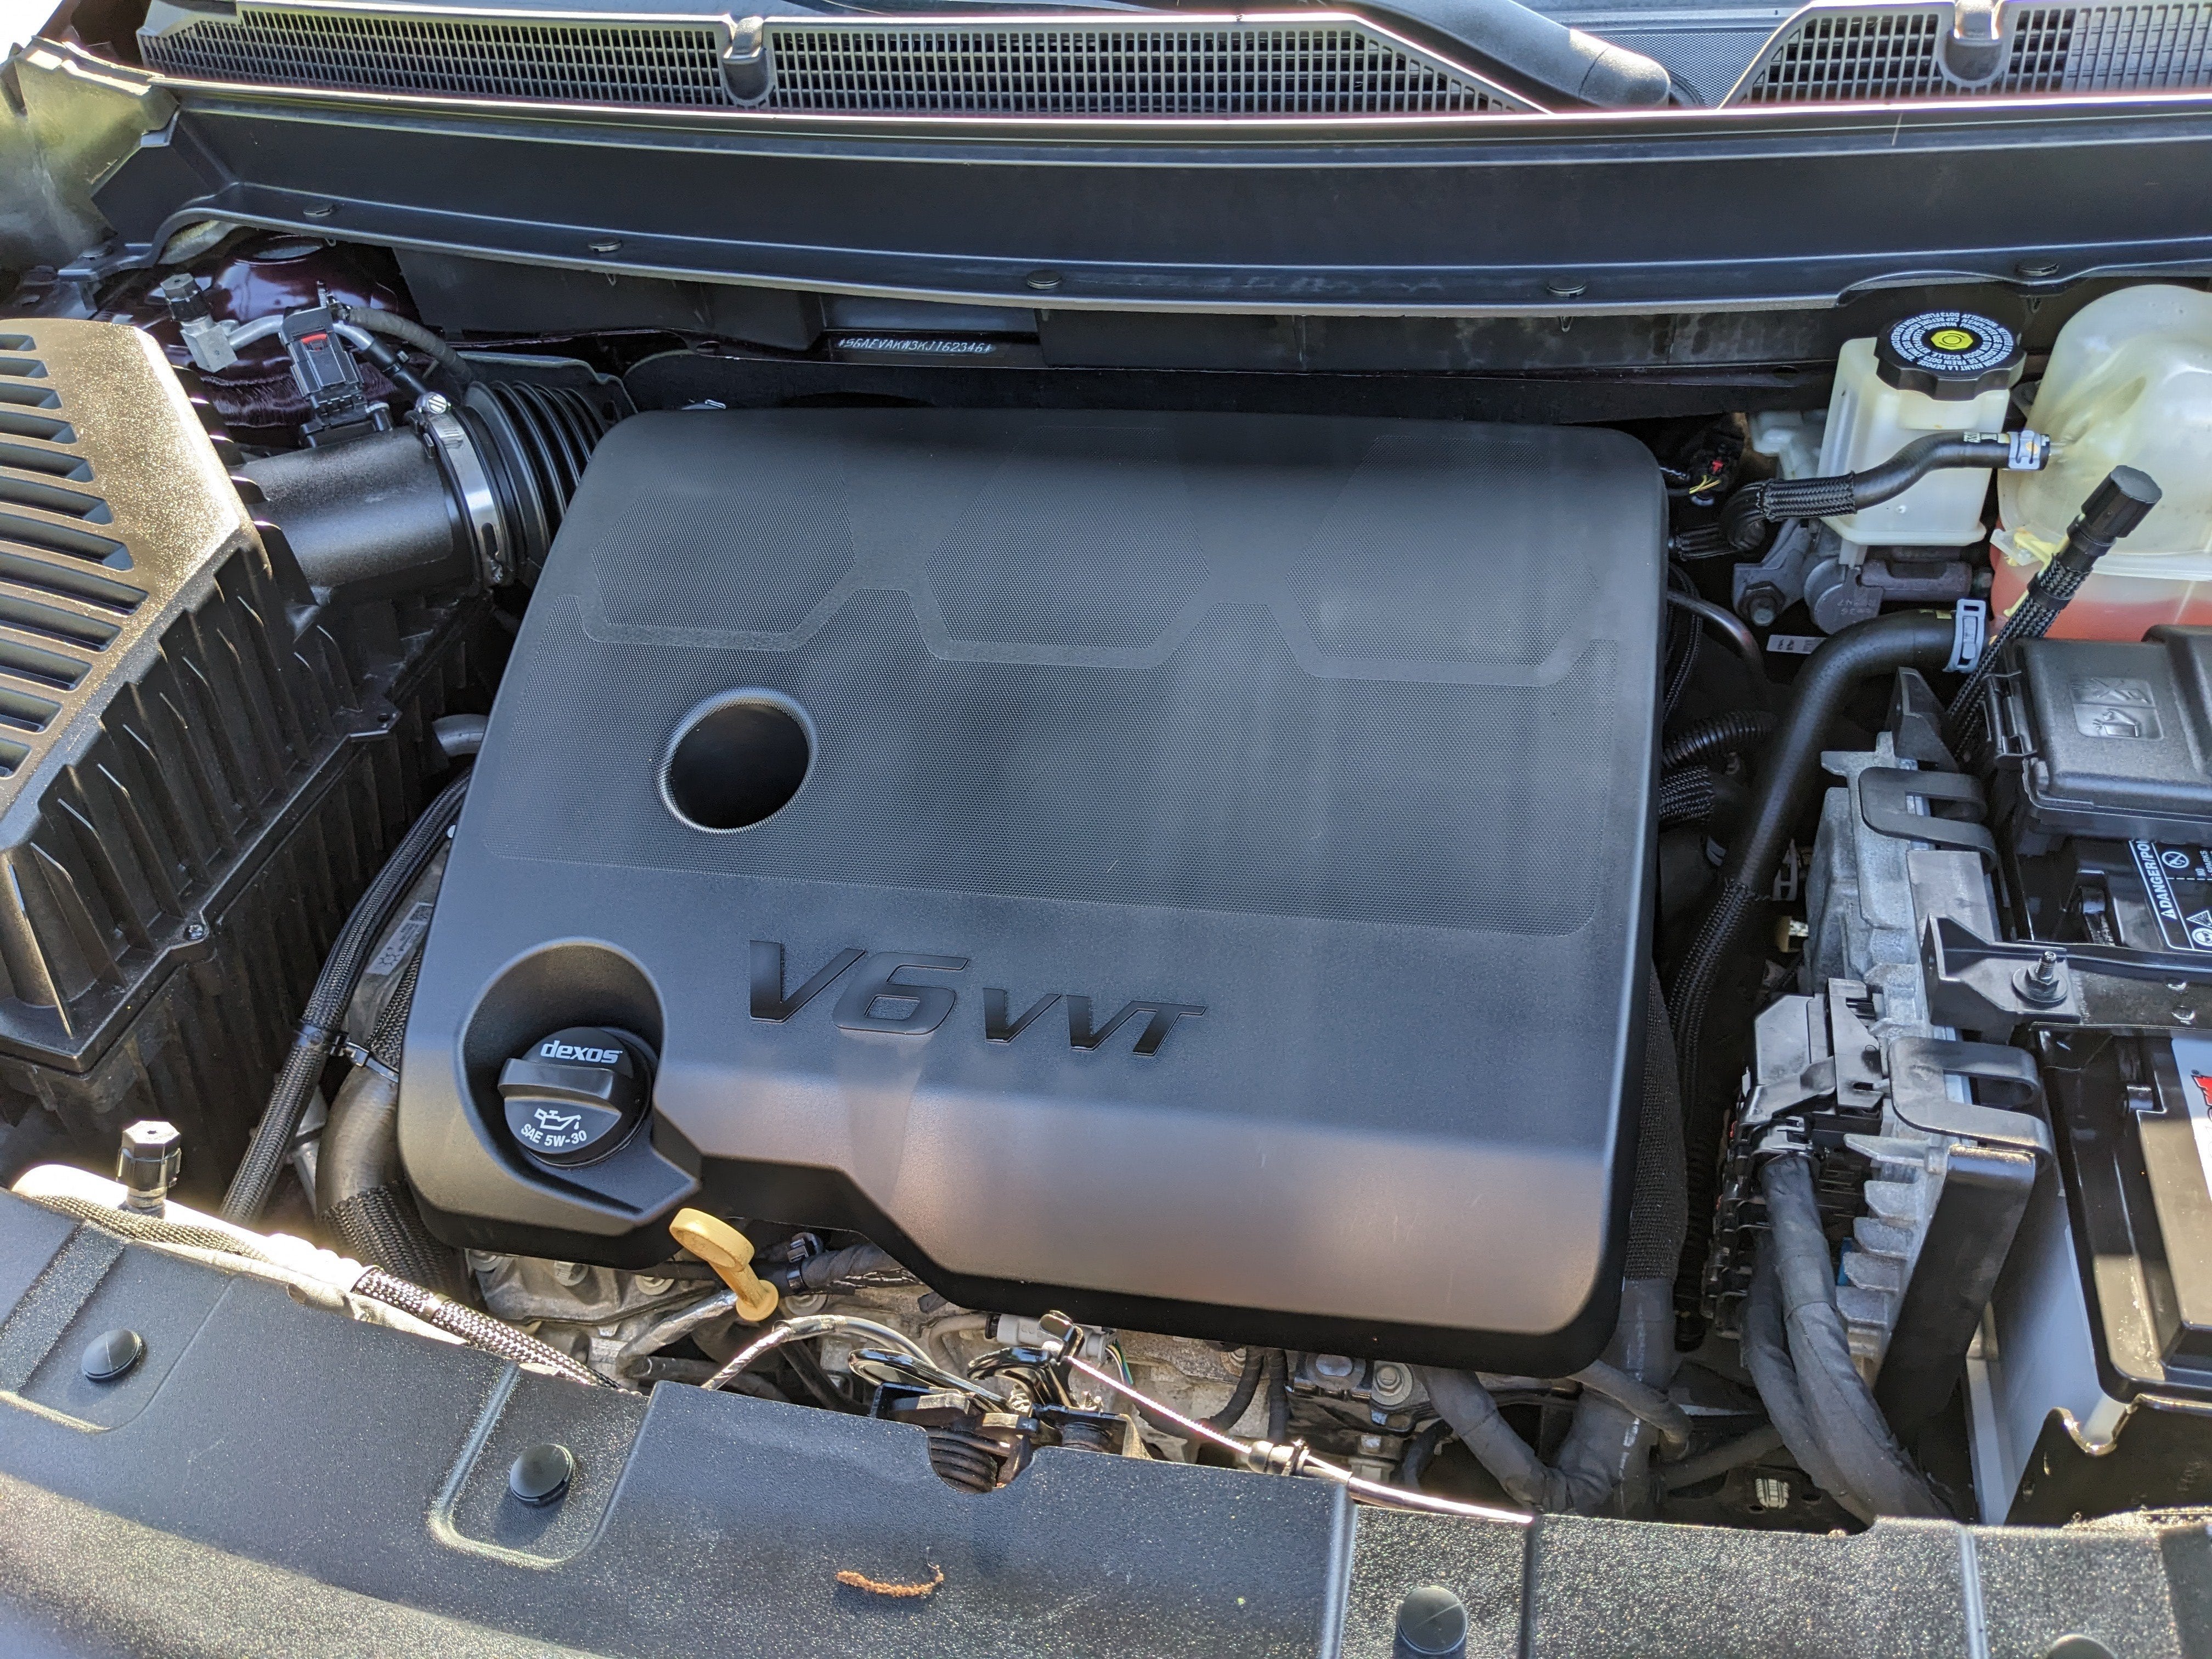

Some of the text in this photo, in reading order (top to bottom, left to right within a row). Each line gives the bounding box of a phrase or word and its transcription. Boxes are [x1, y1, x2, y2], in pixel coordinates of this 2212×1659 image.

[1902, 317, 1921, 326] FROM
[1902, 341, 1914, 349] USE
[1962, 349, 1985, 359] BIDON
[749, 939, 1206, 1056] V6 VVT
[540, 1040, 620, 1063] dexos
[521, 1124, 587, 1147] SAE 5W-30
